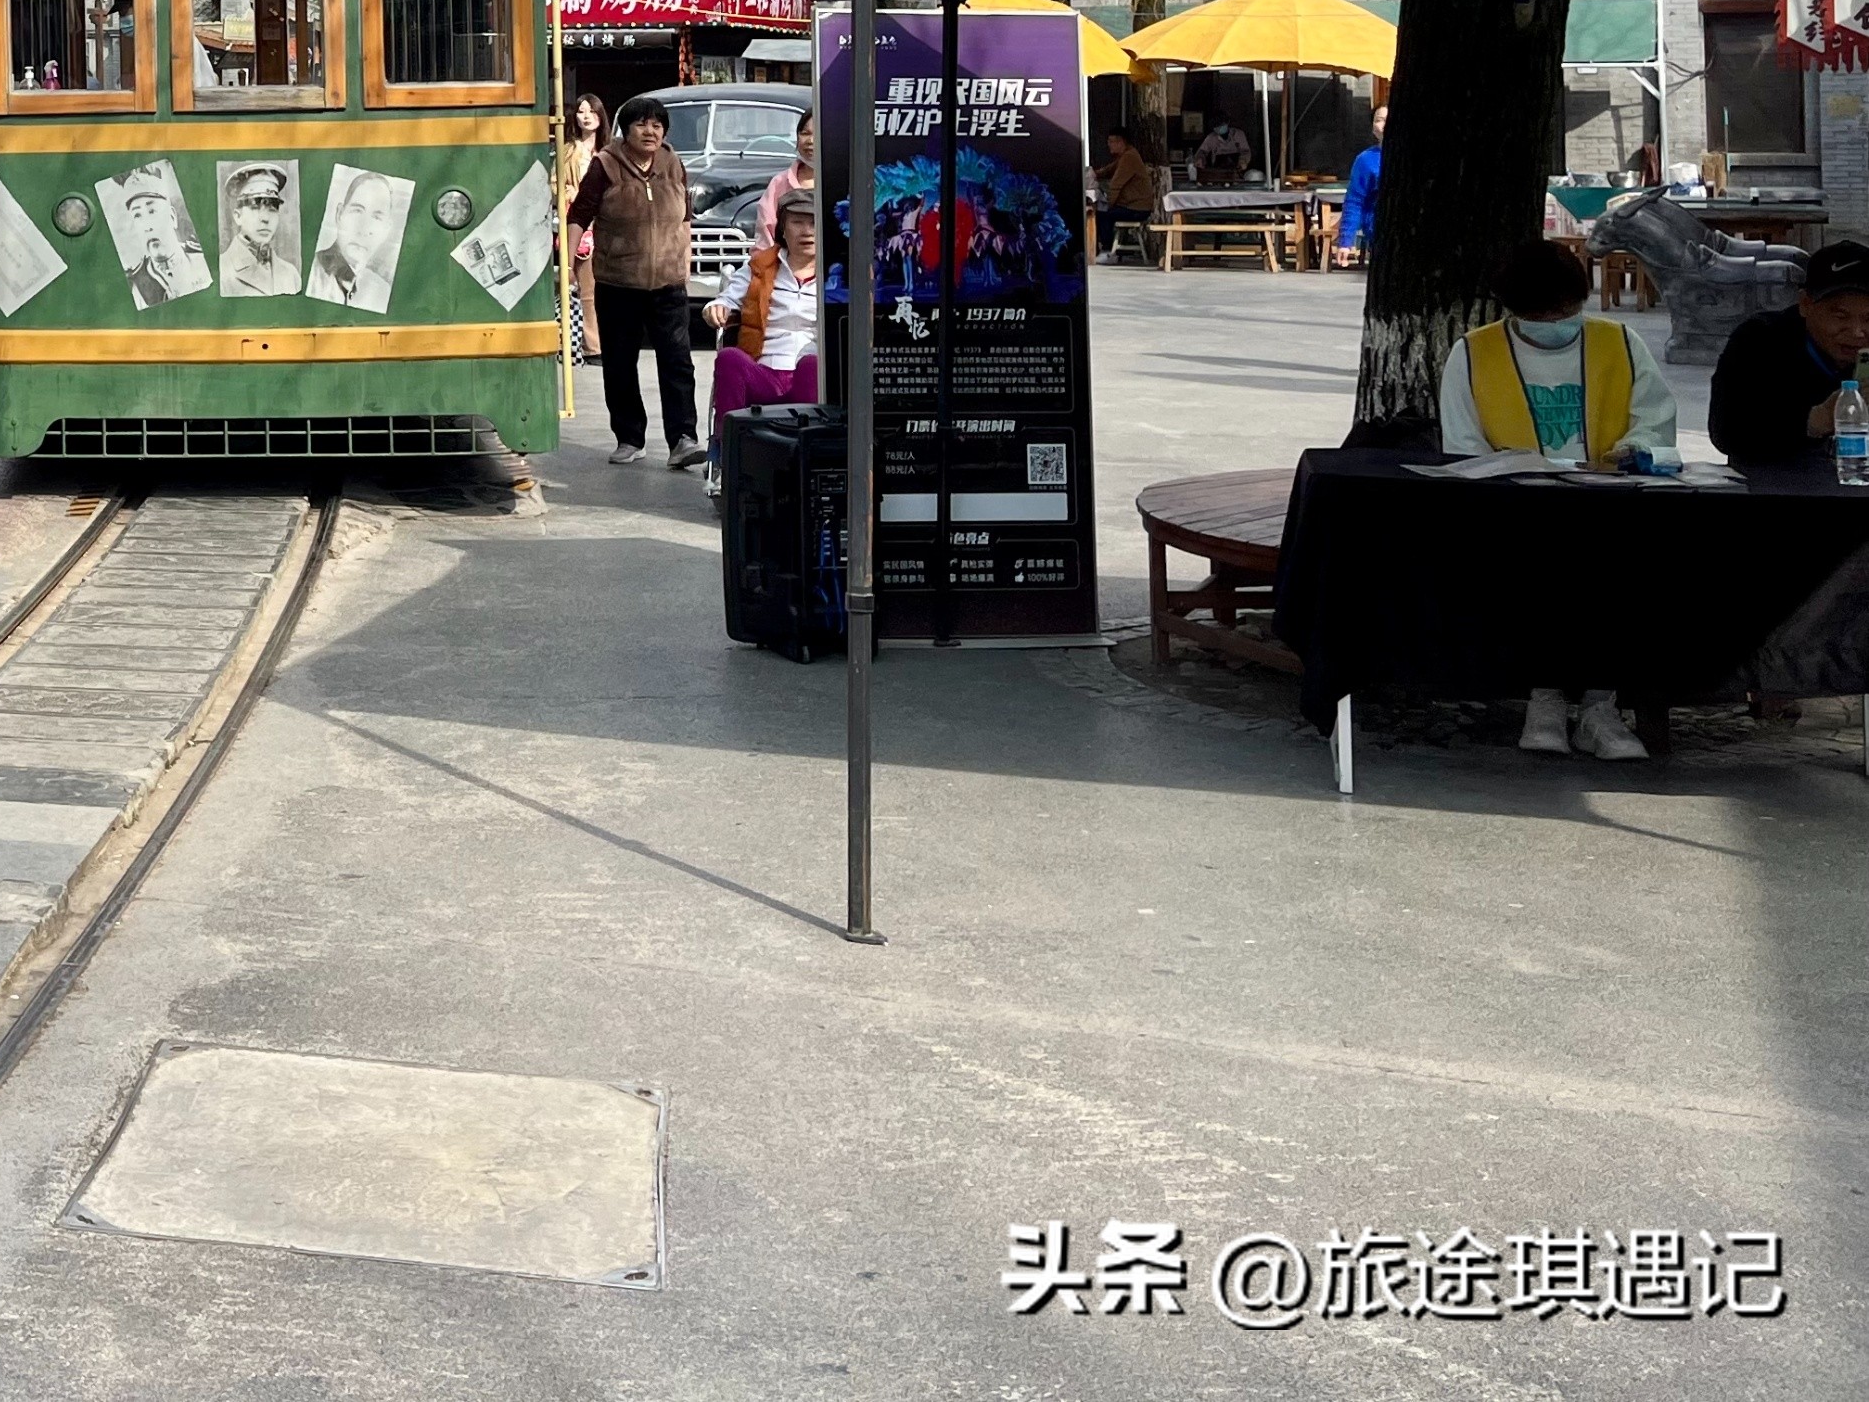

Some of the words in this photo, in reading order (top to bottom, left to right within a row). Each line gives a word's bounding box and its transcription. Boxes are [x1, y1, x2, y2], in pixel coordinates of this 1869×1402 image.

[889, 296, 931, 340] 再忆
[966, 308, 1002, 321] 1937
[1003, 308, 1027, 321] 简介
[906, 420, 1016, 433] 门票价及演出时间
[950, 532, 990, 545] 色亮点
